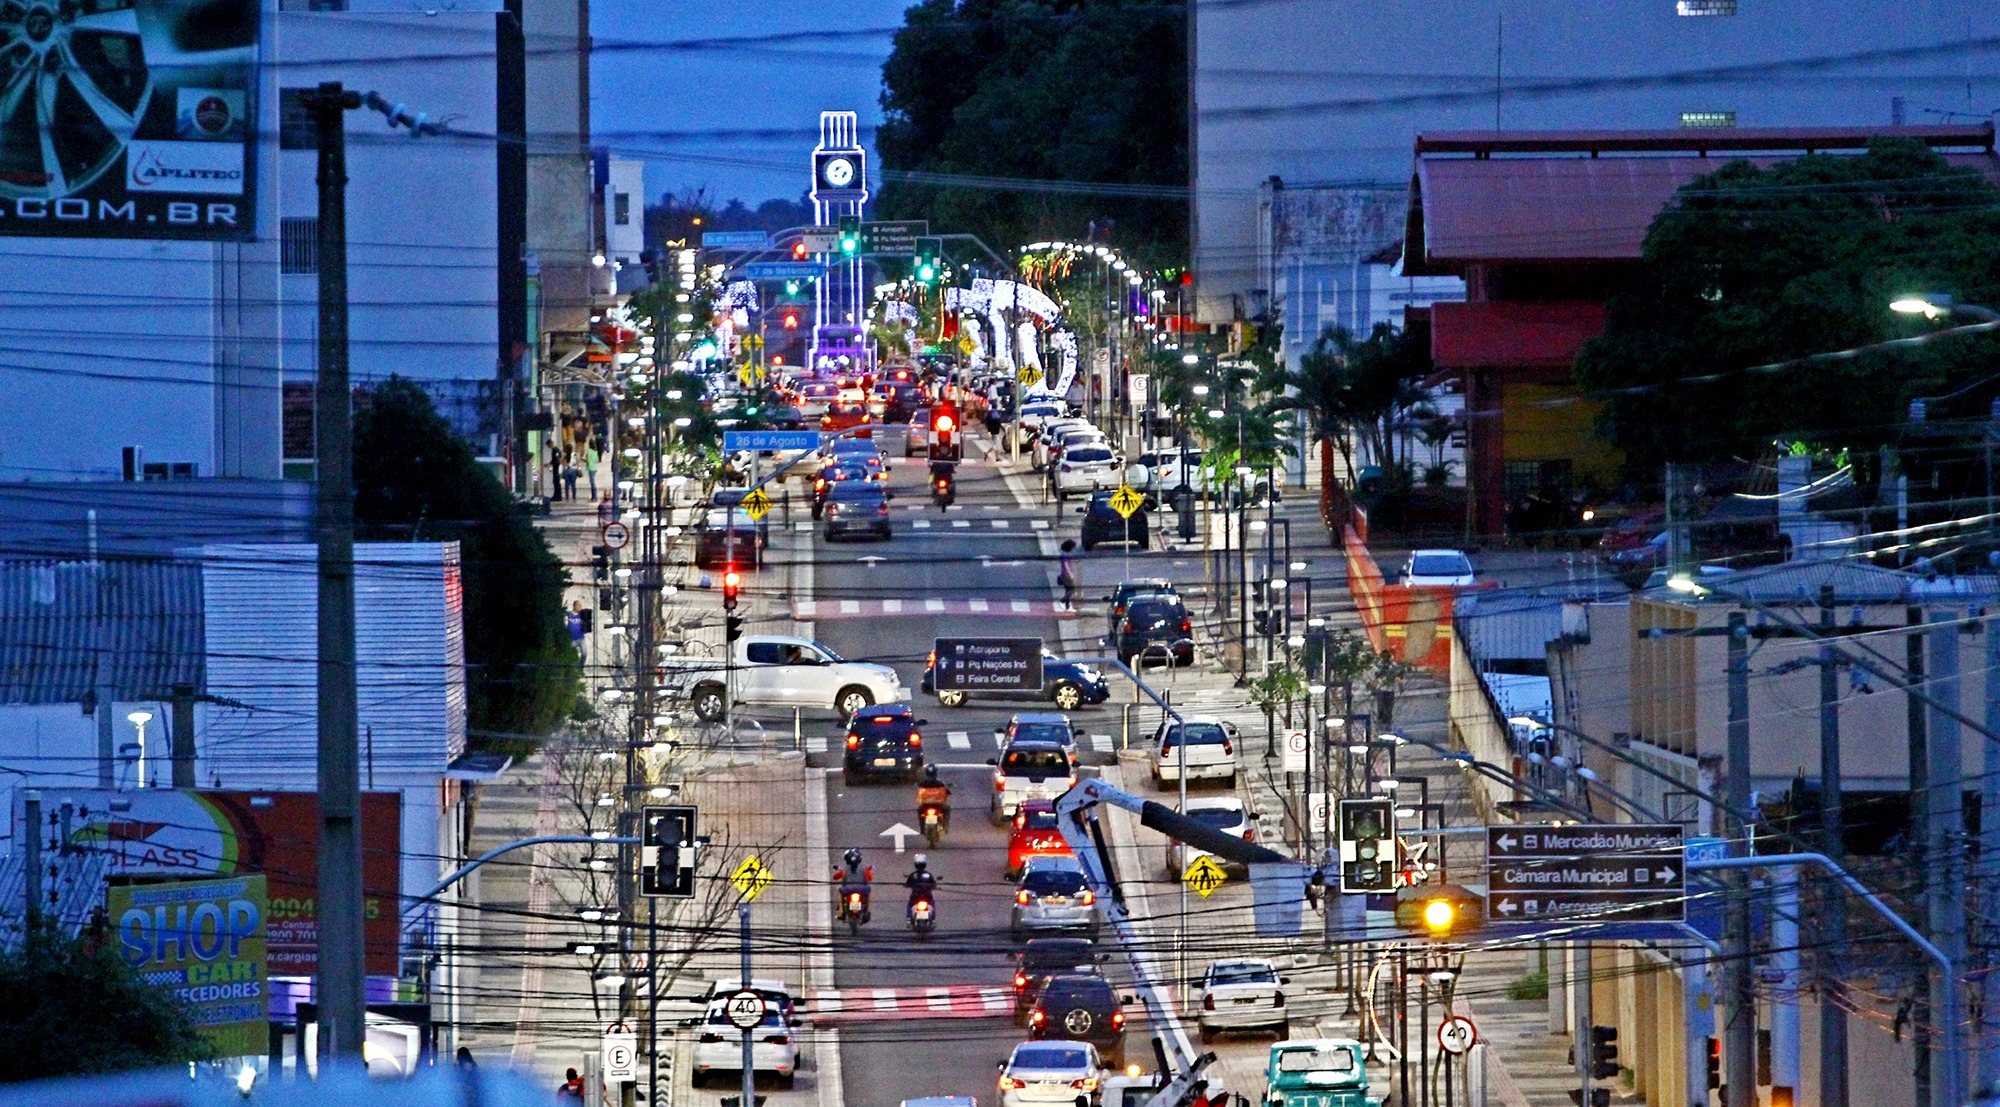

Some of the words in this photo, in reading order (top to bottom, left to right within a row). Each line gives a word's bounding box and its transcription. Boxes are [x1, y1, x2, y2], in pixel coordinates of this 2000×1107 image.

[142, 167, 241, 180] APLITEC
[735, 436, 750, 446] 26
[752, 435, 766, 446] de
[768, 435, 808, 448] Agosto
[968, 645, 1011, 655] Aeroporto
[982, 660, 1013, 670] Nações
[968, 674, 990, 683] Feira
[990, 674, 1021, 683] Central
[1543, 832, 1616, 850] Mercadão
[1616, 833, 1682, 849] Municipal
[1503, 868, 1562, 883] Câmara
[1562, 868, 1628, 886] Municipal
[281, 920, 315, 930] Central
[118, 899, 260, 968] SHOP
[187, 960, 252, 986] CAR
[735, 999, 756, 1014] 40
[1447, 1026, 1467, 1040] 40
[615, 1049, 625, 1065] E
